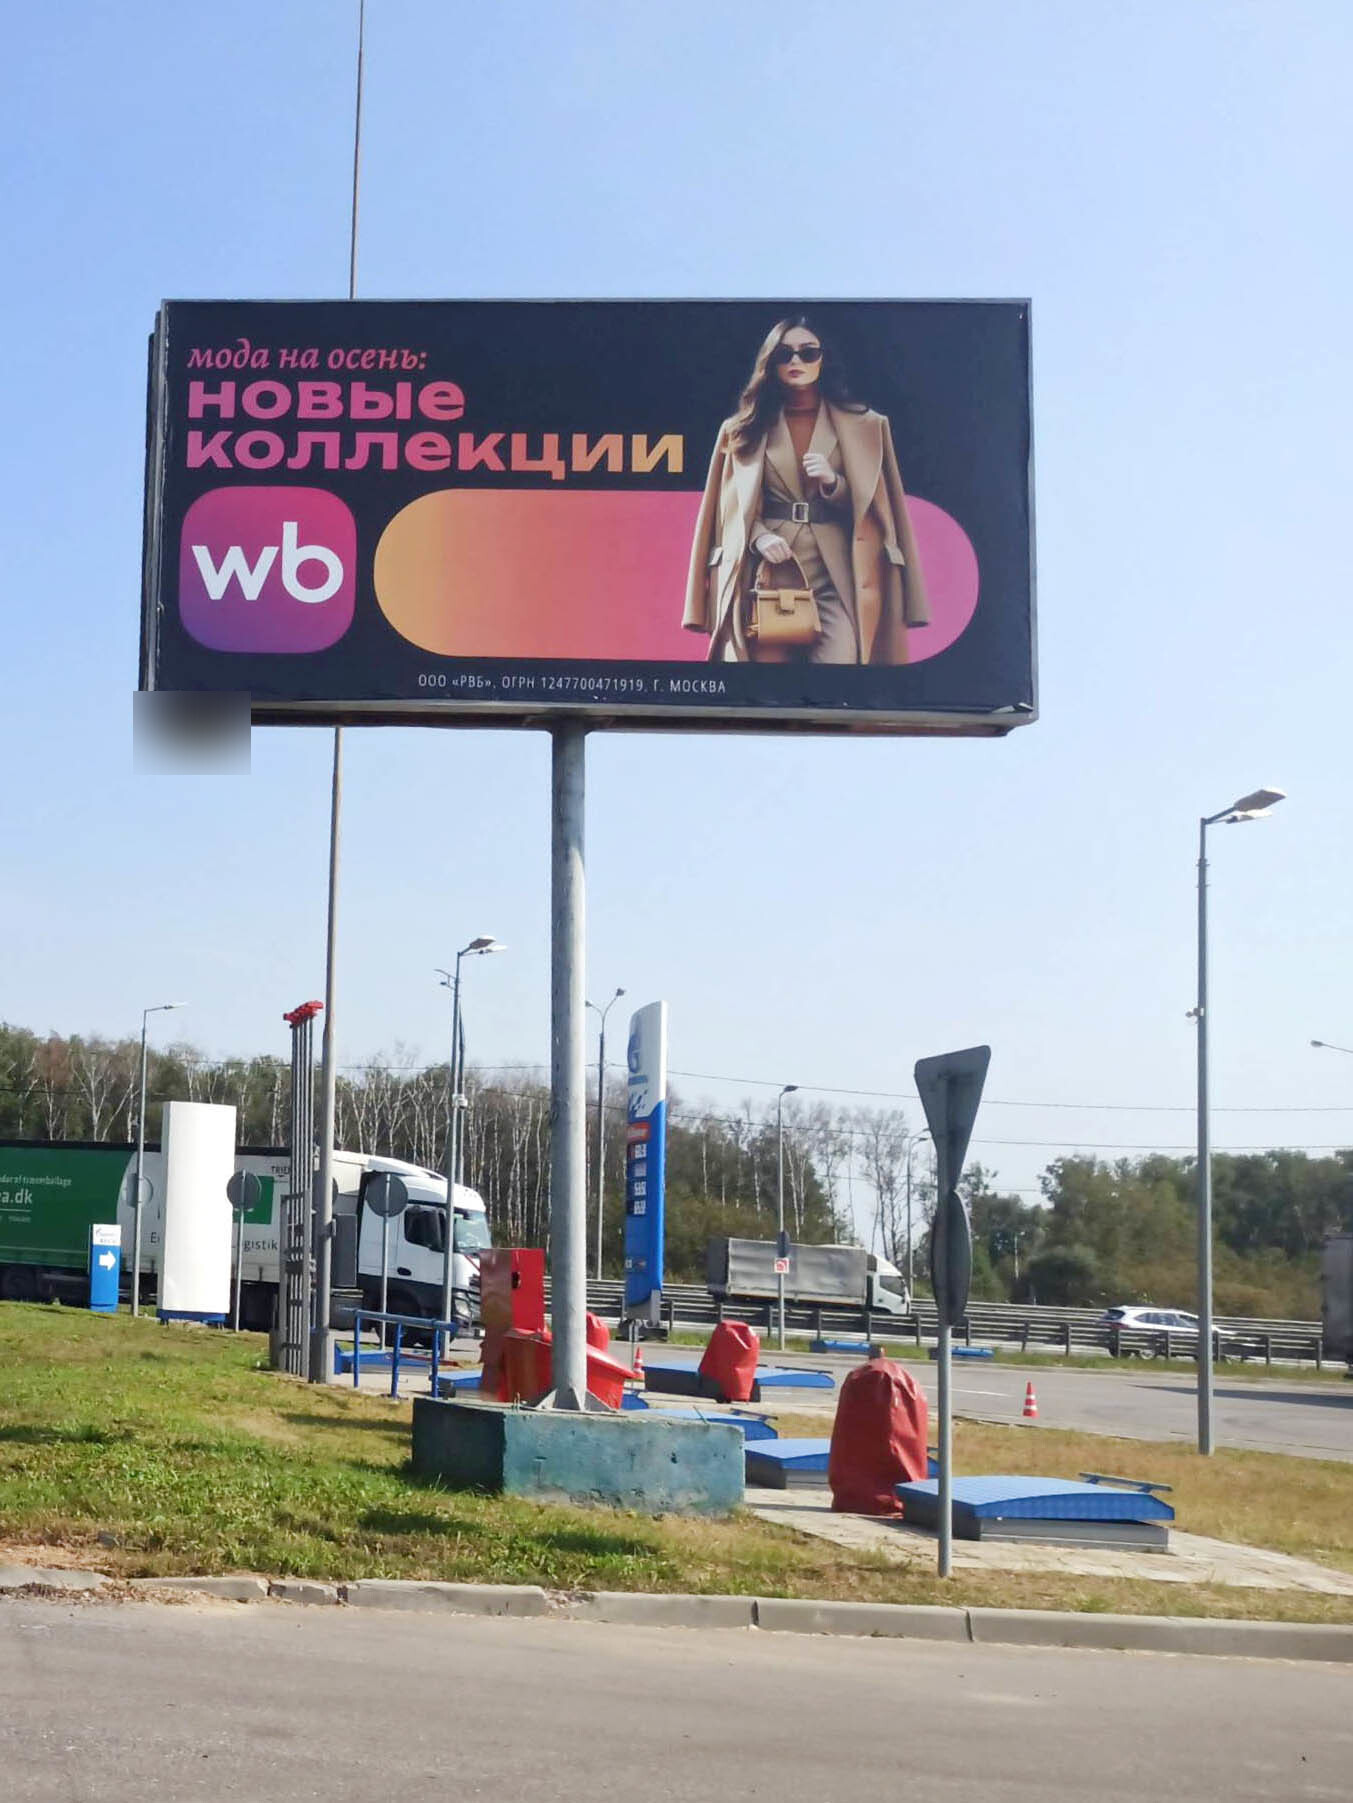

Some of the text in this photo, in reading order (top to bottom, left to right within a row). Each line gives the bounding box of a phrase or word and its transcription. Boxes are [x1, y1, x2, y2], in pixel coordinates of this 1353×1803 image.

[187, 338, 427, 371] мода на осень:
[186, 430, 684, 480] коллекции
[191, 521, 344, 604] wb
[418, 673, 447, 687] ООО
[501, 675, 535, 689] ОГРН
[653, 679, 665, 692] Г.
[670, 679, 726, 693] МОСКВА
